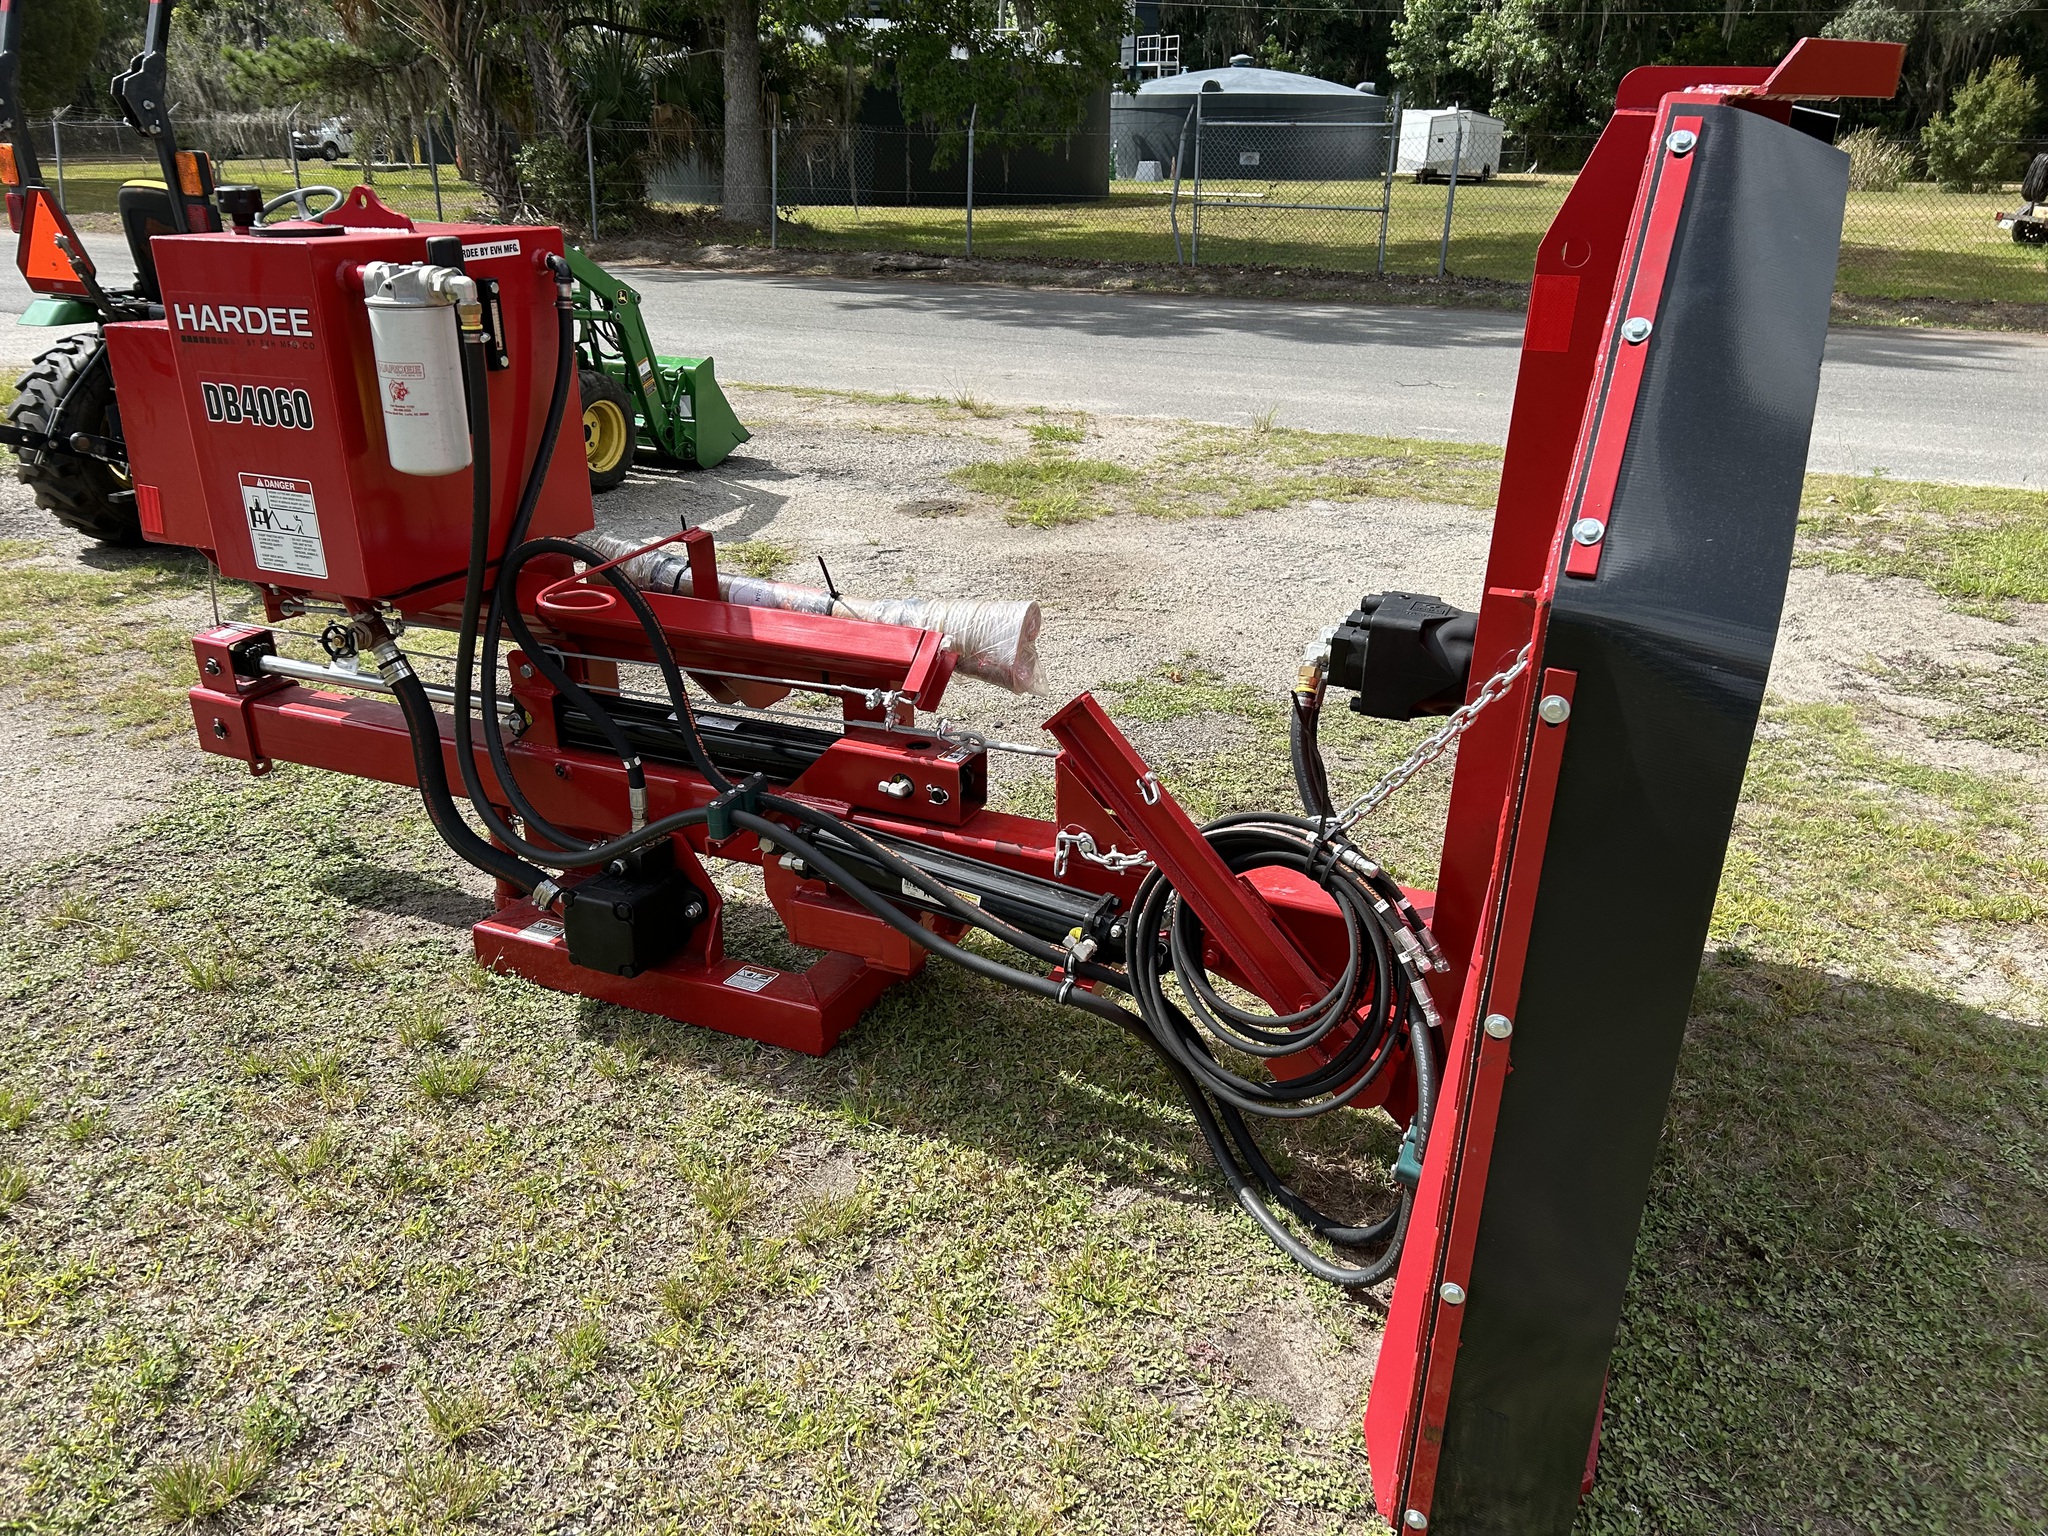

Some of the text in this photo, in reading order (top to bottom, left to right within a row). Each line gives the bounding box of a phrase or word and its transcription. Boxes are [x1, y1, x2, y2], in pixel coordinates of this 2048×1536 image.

[462, 248, 479, 258] RDEE
[480, 247, 488, 256] BY
[490, 246, 502, 255] EVH
[173, 303, 313, 337] HARDEE
[201, 382, 314, 430] DB4060
[264, 479, 296, 491] DANGER
